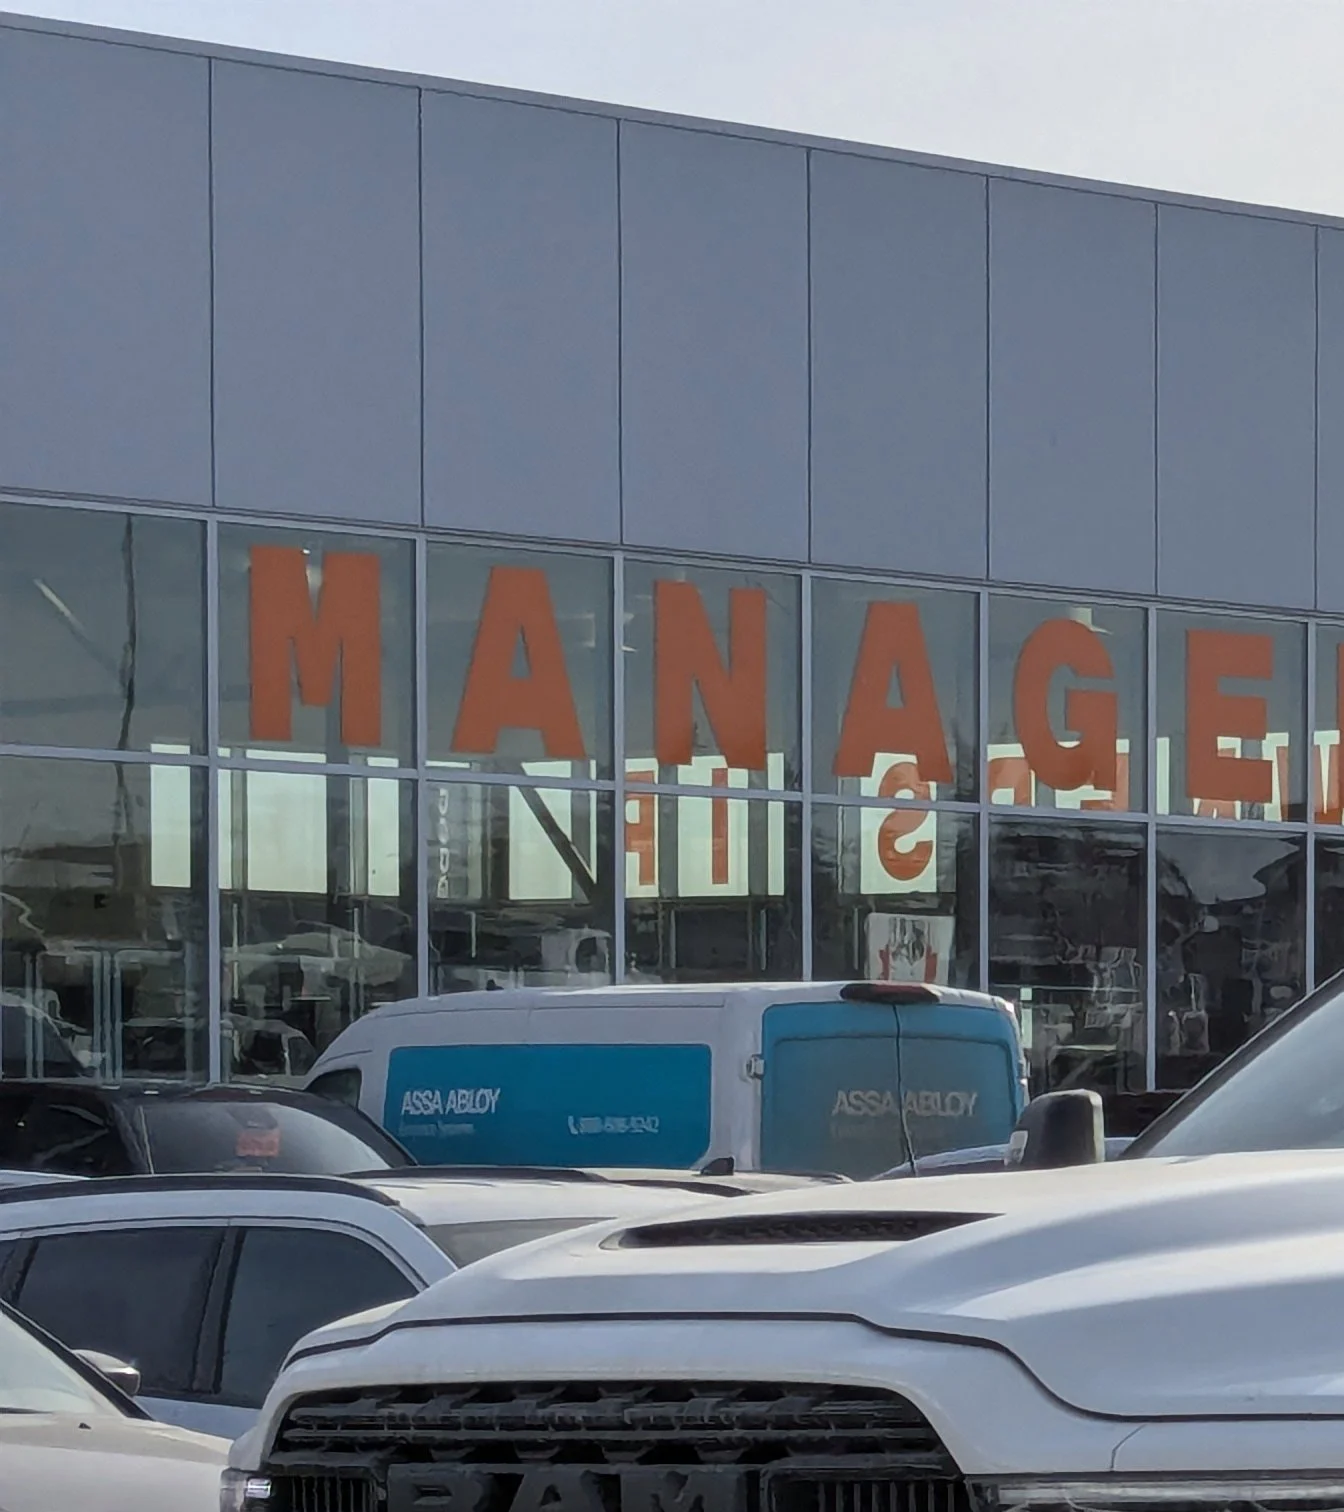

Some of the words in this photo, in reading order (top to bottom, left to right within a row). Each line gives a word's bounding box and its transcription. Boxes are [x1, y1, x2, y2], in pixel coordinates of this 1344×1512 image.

[402, 1088, 443, 1116] ASSA
[445, 1088, 501, 1115] ABLOY
[831, 1090, 898, 1117] ASSA
[902, 1090, 978, 1117] ABLOY
